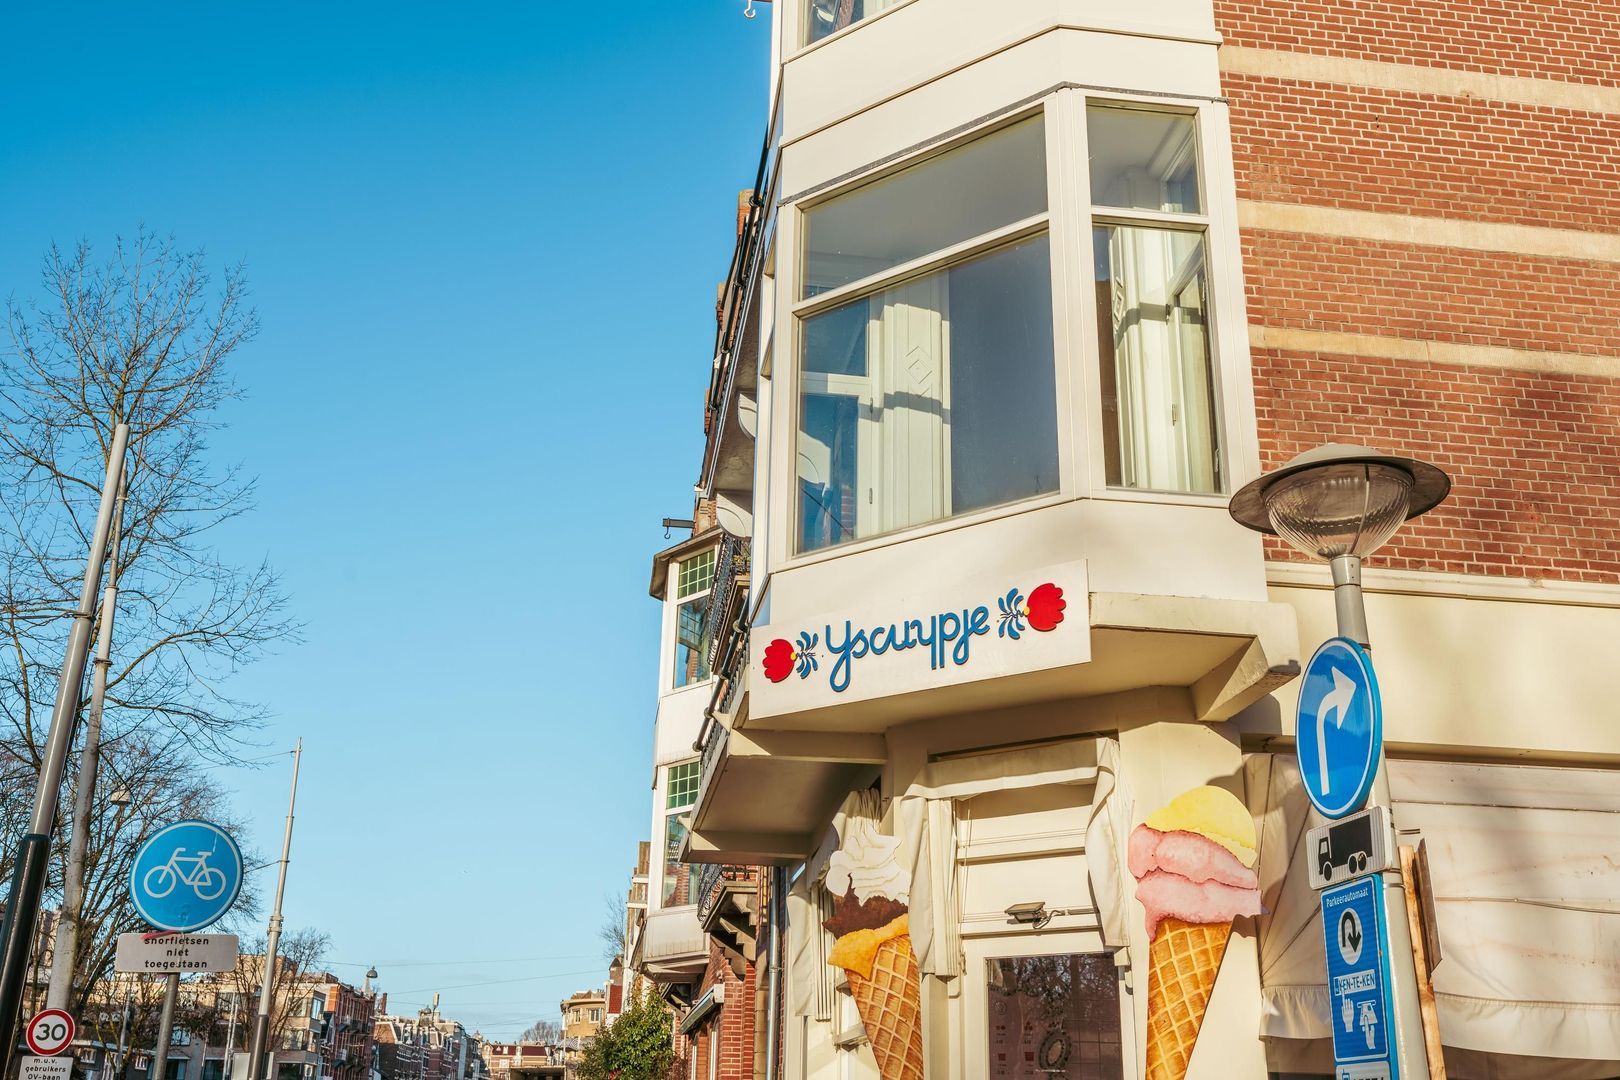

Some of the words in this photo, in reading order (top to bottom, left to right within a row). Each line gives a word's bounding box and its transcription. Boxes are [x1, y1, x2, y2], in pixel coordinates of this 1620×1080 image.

[1325, 887, 1369, 908] Parkeerautomaat
[144, 936, 209, 945] snorfietsen
[166, 948, 190, 957] niet
[35, 1023, 67, 1042] 30
[25, 1065, 67, 1074] gebruikers
